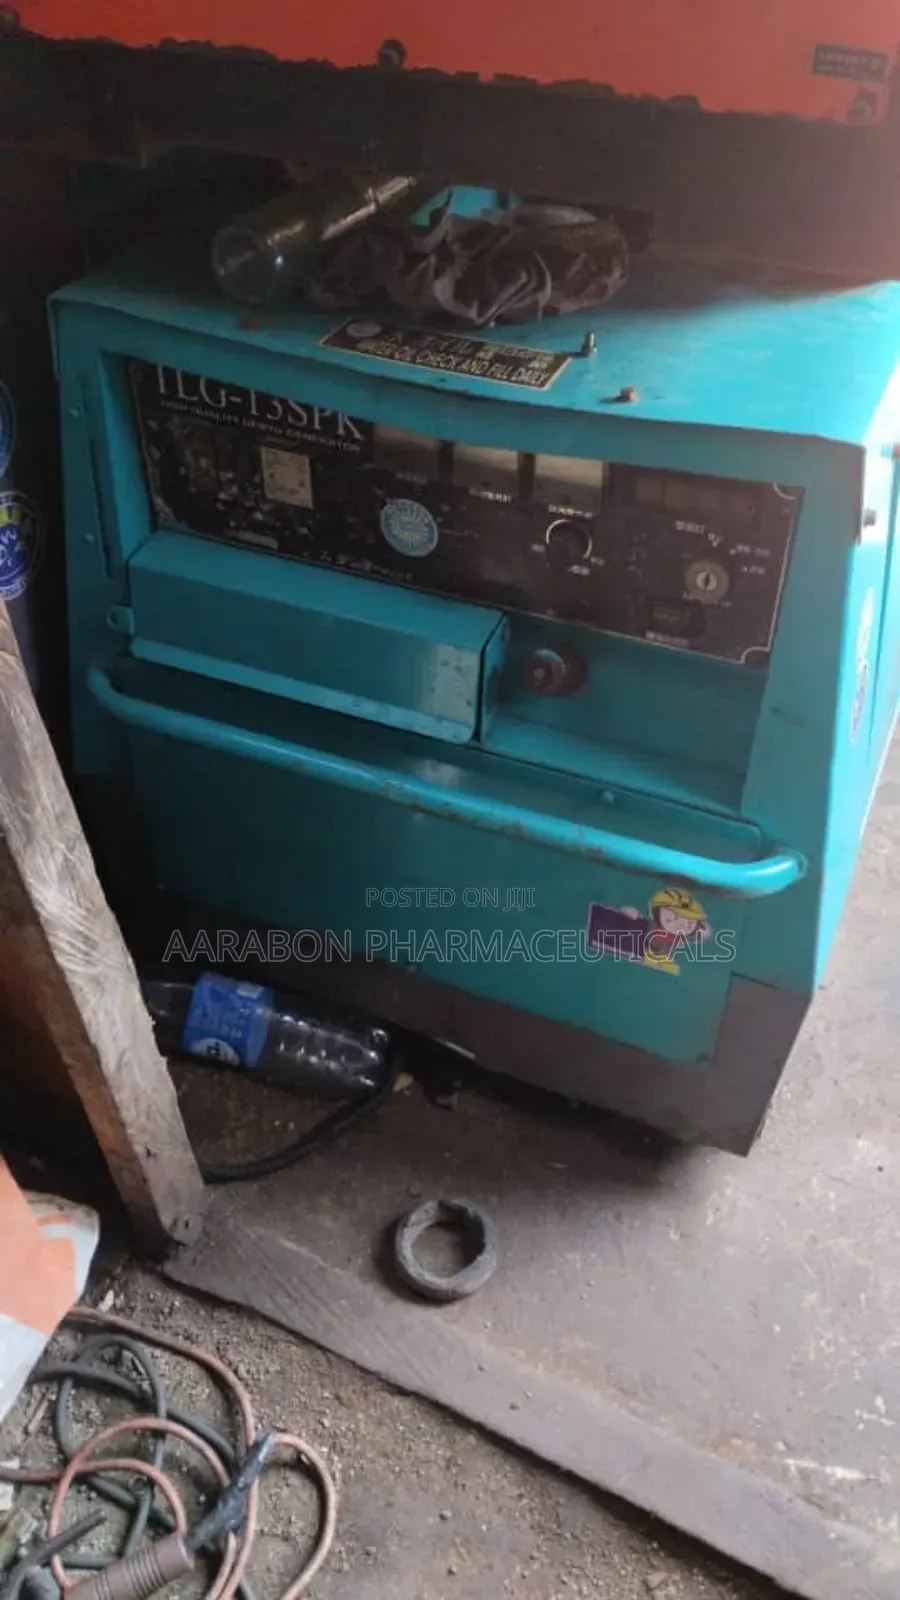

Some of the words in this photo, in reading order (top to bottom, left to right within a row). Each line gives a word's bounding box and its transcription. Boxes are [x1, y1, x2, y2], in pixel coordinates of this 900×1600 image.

[460, 357, 490, 375] AND
[511, 366, 550, 385] DAILY
[285, 428, 361, 453] GENERATOR
